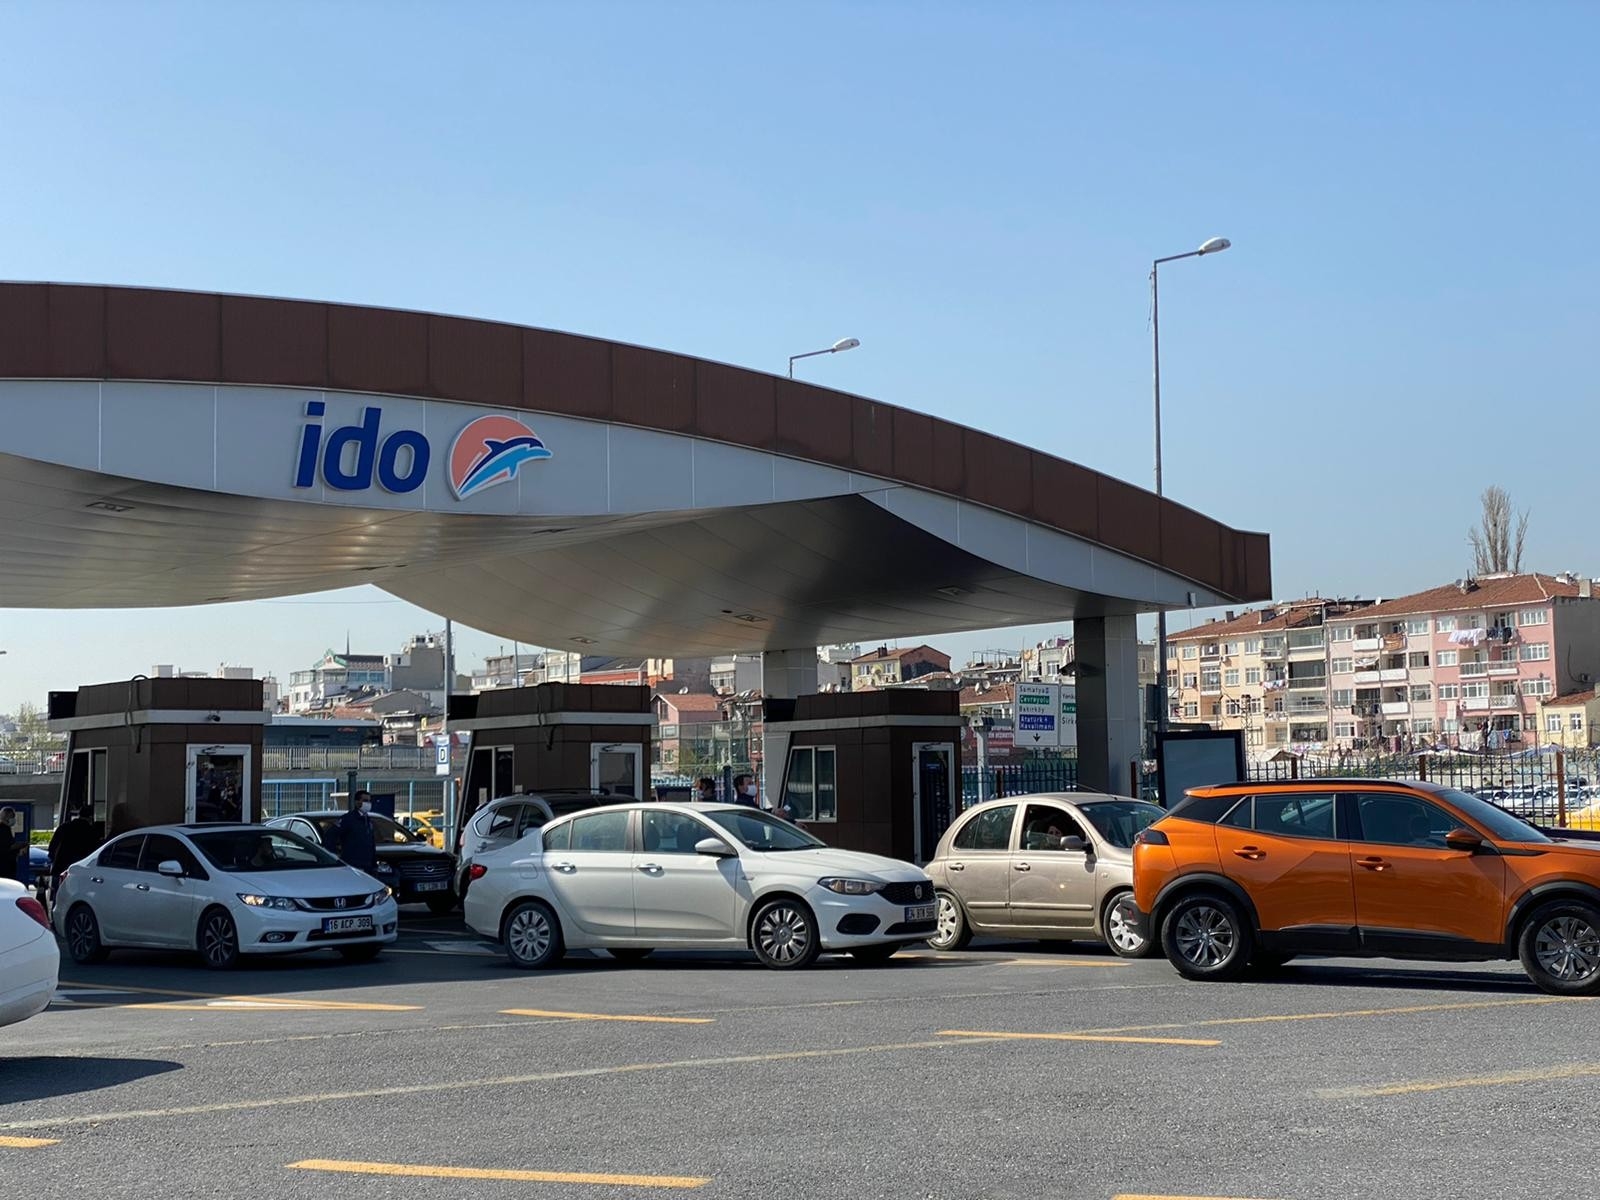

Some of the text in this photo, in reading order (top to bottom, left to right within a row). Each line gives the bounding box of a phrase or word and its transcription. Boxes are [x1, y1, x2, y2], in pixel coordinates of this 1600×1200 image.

[295, 400, 430, 494] ido
[1019, 685, 1045, 694] Samatya
[1062, 716, 1077, 725] Sirk
[330, 917, 371, 930] 16 ACP 309
